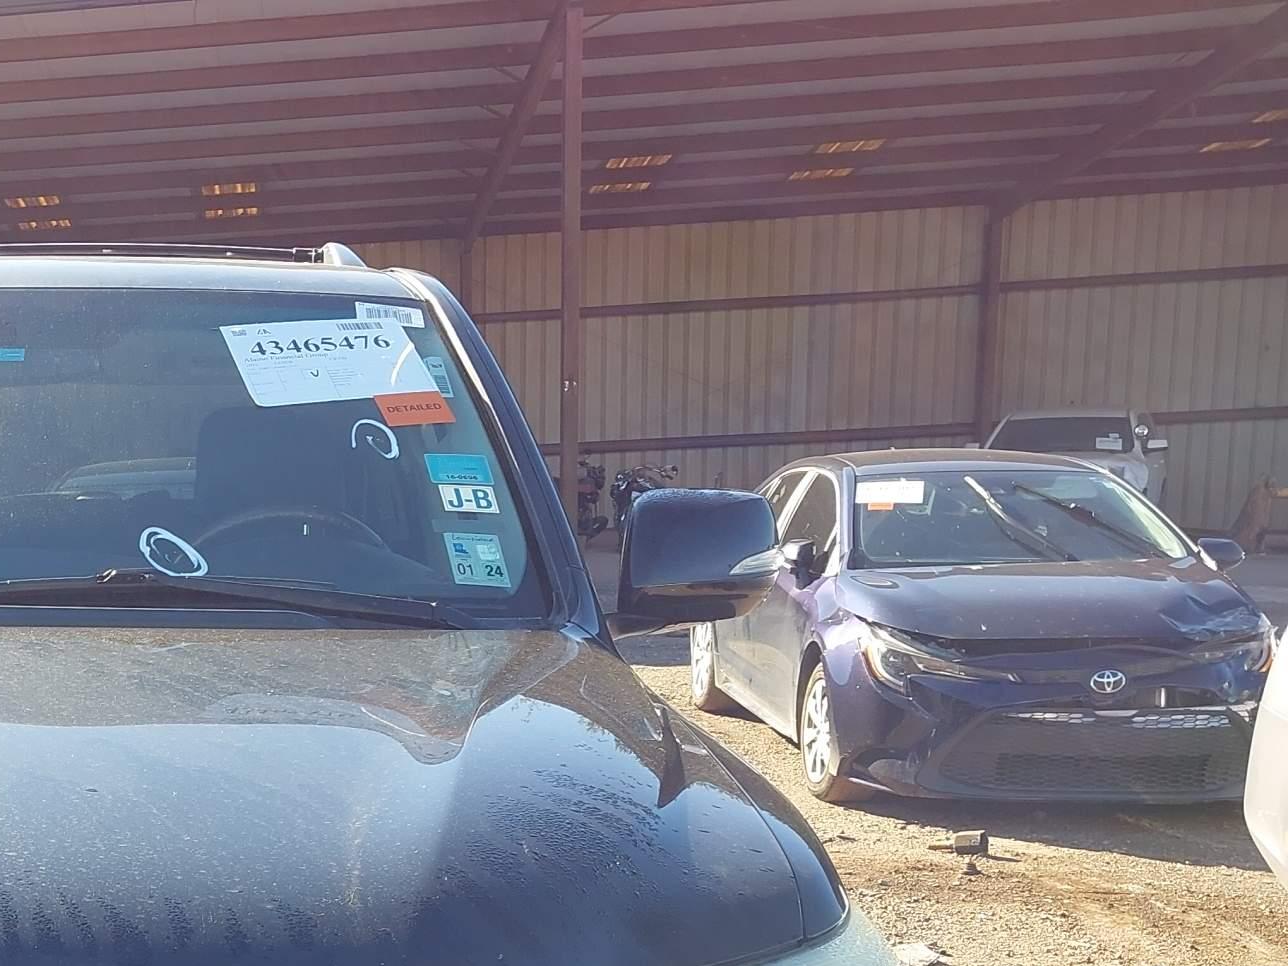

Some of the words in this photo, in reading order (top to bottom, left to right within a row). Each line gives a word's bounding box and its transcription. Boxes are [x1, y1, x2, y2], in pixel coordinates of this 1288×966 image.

[250, 335, 391, 356] 43465476
[386, 402, 442, 413] DETAILED
[448, 488, 493, 509] J-B
[457, 562, 474, 576] 01
[484, 564, 504, 577] 24
